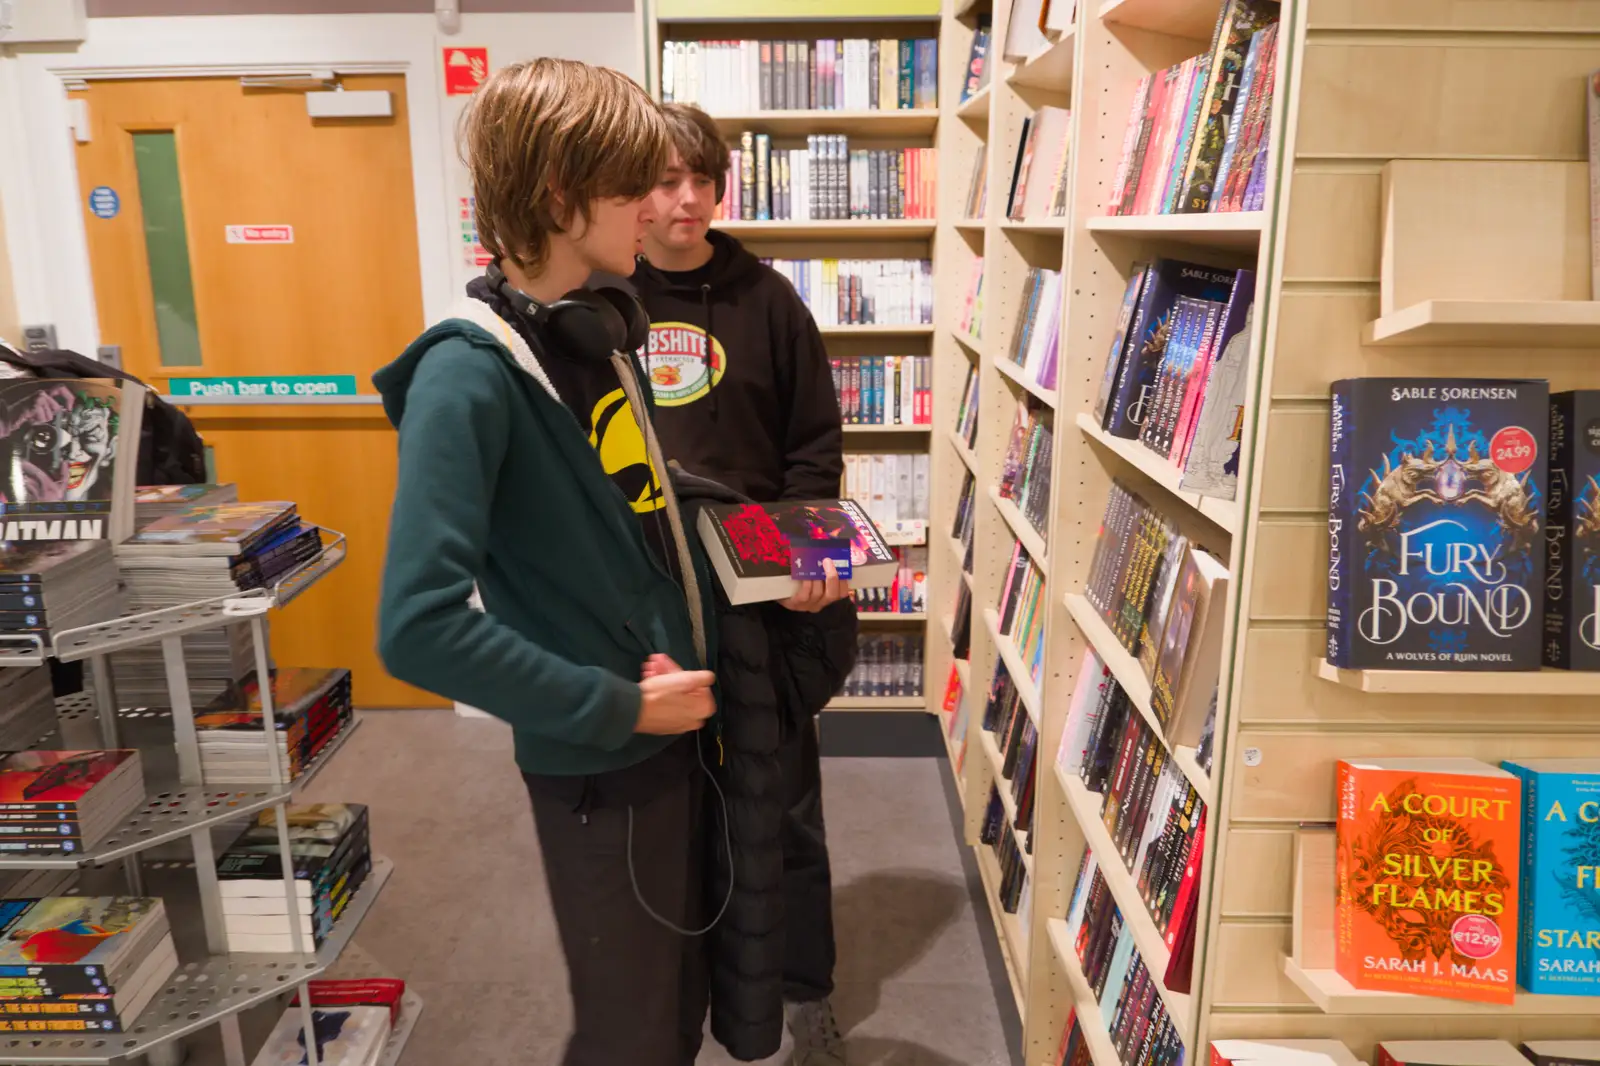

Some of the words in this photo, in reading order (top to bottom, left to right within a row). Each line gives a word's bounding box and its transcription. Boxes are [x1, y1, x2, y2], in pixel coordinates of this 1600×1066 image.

[1181, 268, 1210, 280] SABLE
[648, 329, 707, 357] BSHITE
[190, 381, 234, 395] Push
[238, 381, 268, 394] bar
[271, 381, 290, 394] to
[293, 382, 338, 395] open
[1391, 387, 1437, 401] SABLE
[1440, 388, 1517, 401] SORENSEN
[1497, 445, 1532, 461] 24.99
[1331, 463, 1346, 510] FURY
[0, 519, 102, 540] ATMAN
[1328, 512, 1343, 591] BOUND
[1399, 519, 1507, 584] FURY
[1546, 521, 1566, 600] BOUND
[1358, 578, 1531, 645] BOUND
[1396, 653, 1436, 661] WOLVES
[1439, 653, 1451, 661] OF
[1454, 653, 1478, 662] RUIN
[1480, 653, 1513, 662] NOVEL
[1369, 792, 1392, 813] A
[1403, 793, 1512, 822] COURT
[1544, 800, 1568, 822] A
[1579, 801, 1600, 823] C
[1423, 828, 1453, 844] OF
[1384, 854, 1494, 883] SILVER
[1372, 884, 1504, 916] FLAMES
[1453, 931, 1500, 947] €12.99
[1537, 929, 1600, 949] STAR
[1364, 956, 1426, 973] SARAH
[1433, 962, 1444, 976] J.
[1451, 964, 1509, 983] MAAS
[1539, 958, 1600, 973] SARAH
[1151, 997, 1163, 1023] THE
